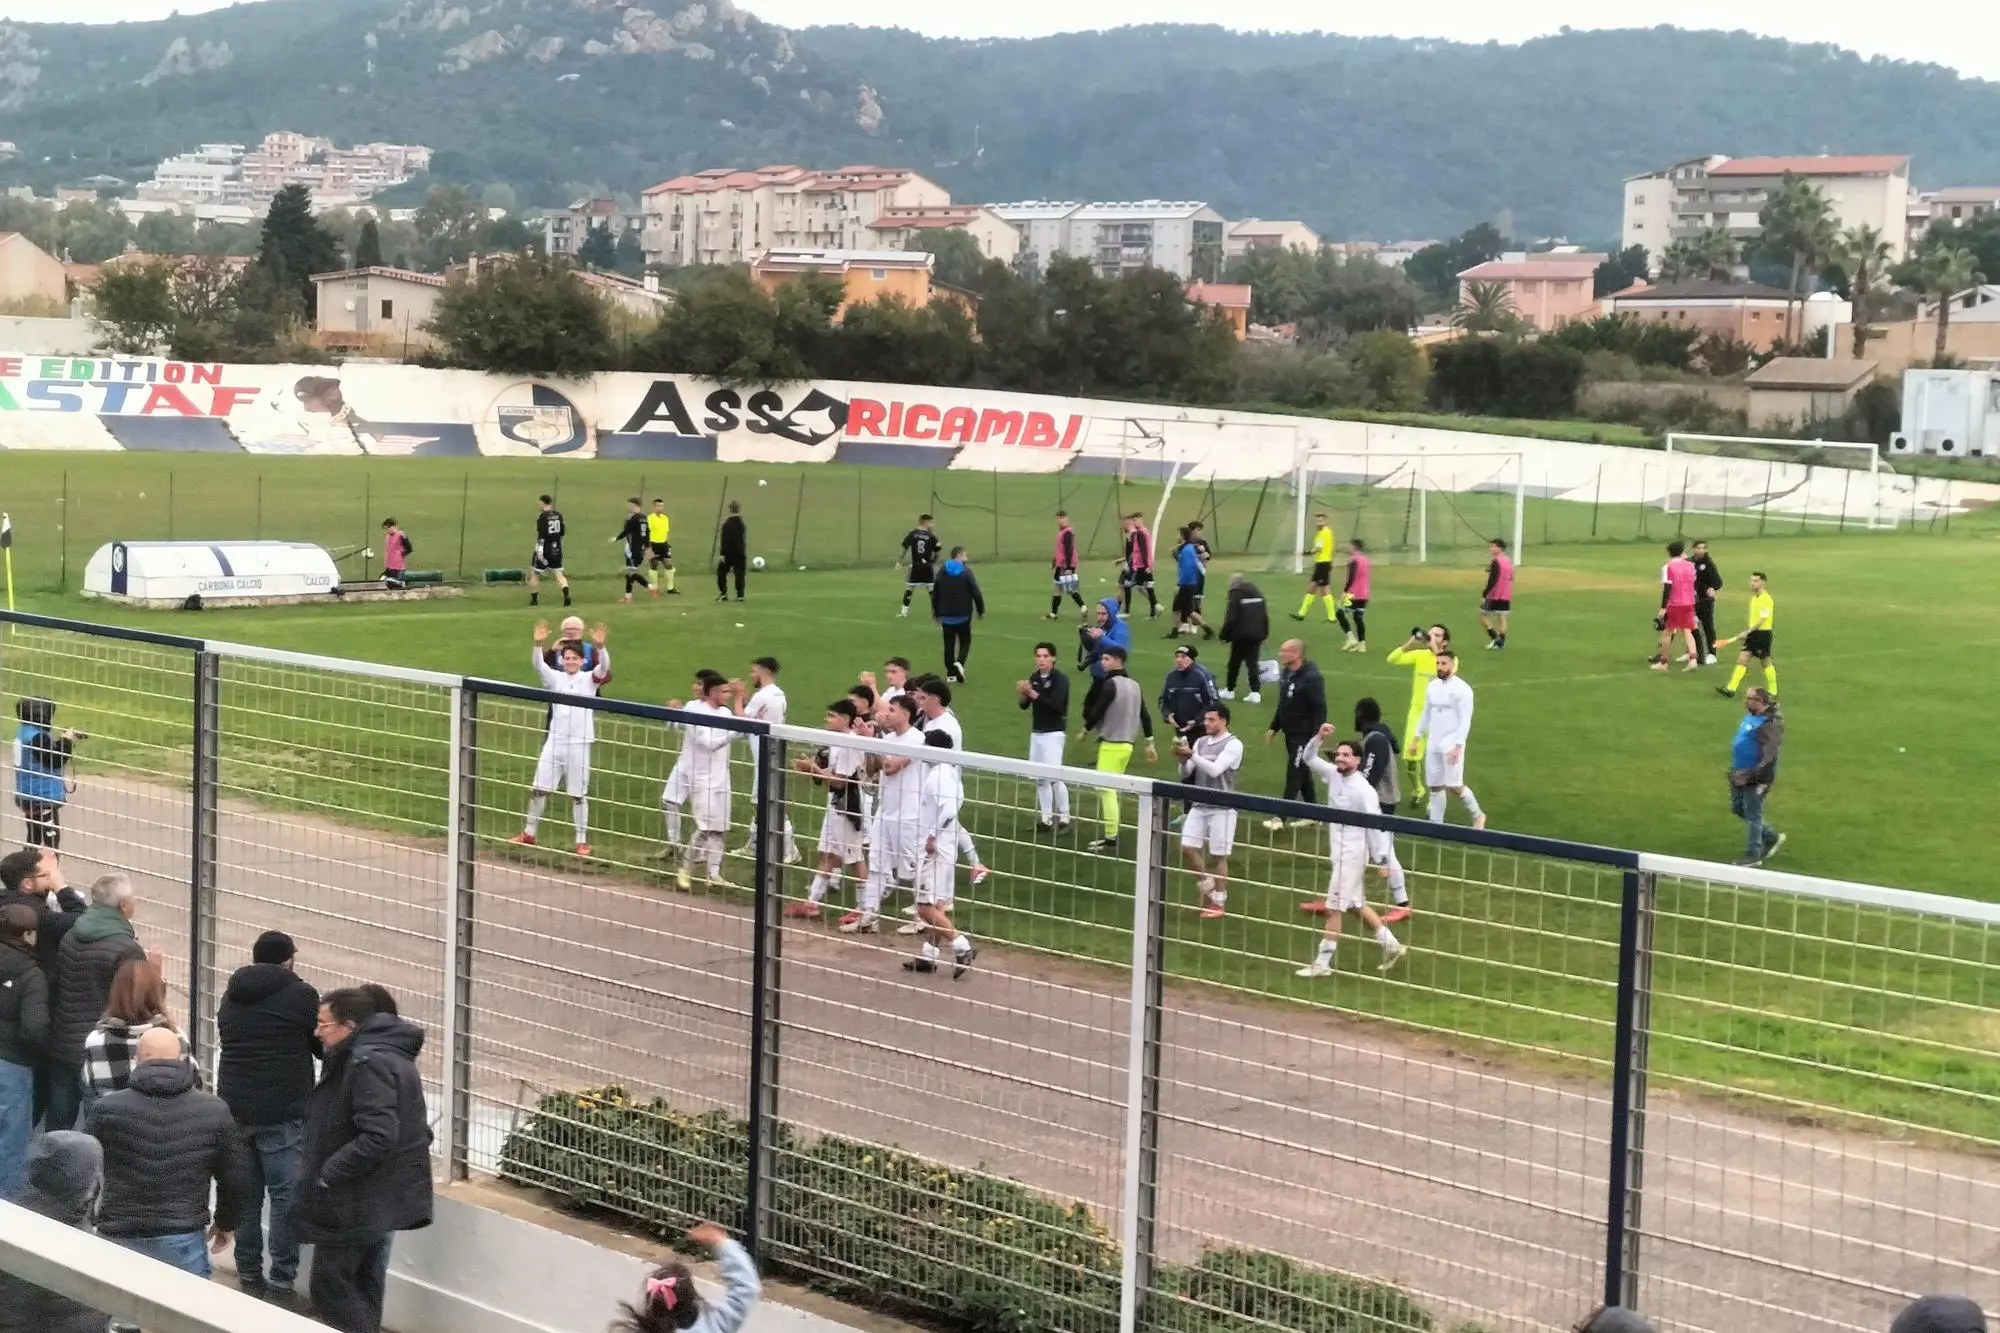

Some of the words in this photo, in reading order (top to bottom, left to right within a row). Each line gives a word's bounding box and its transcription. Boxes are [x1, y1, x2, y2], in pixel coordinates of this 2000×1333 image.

[40, 359, 224, 385] EDITION
[845, 398, 1083, 449] RICAMBI
[548, 519, 561, 534] 20
[917, 540, 926, 554] 8
[198, 580, 235, 591] CARBONIA
[237, 579, 262, 590] CALCIO
[305, 576, 331, 586] CALCIO
